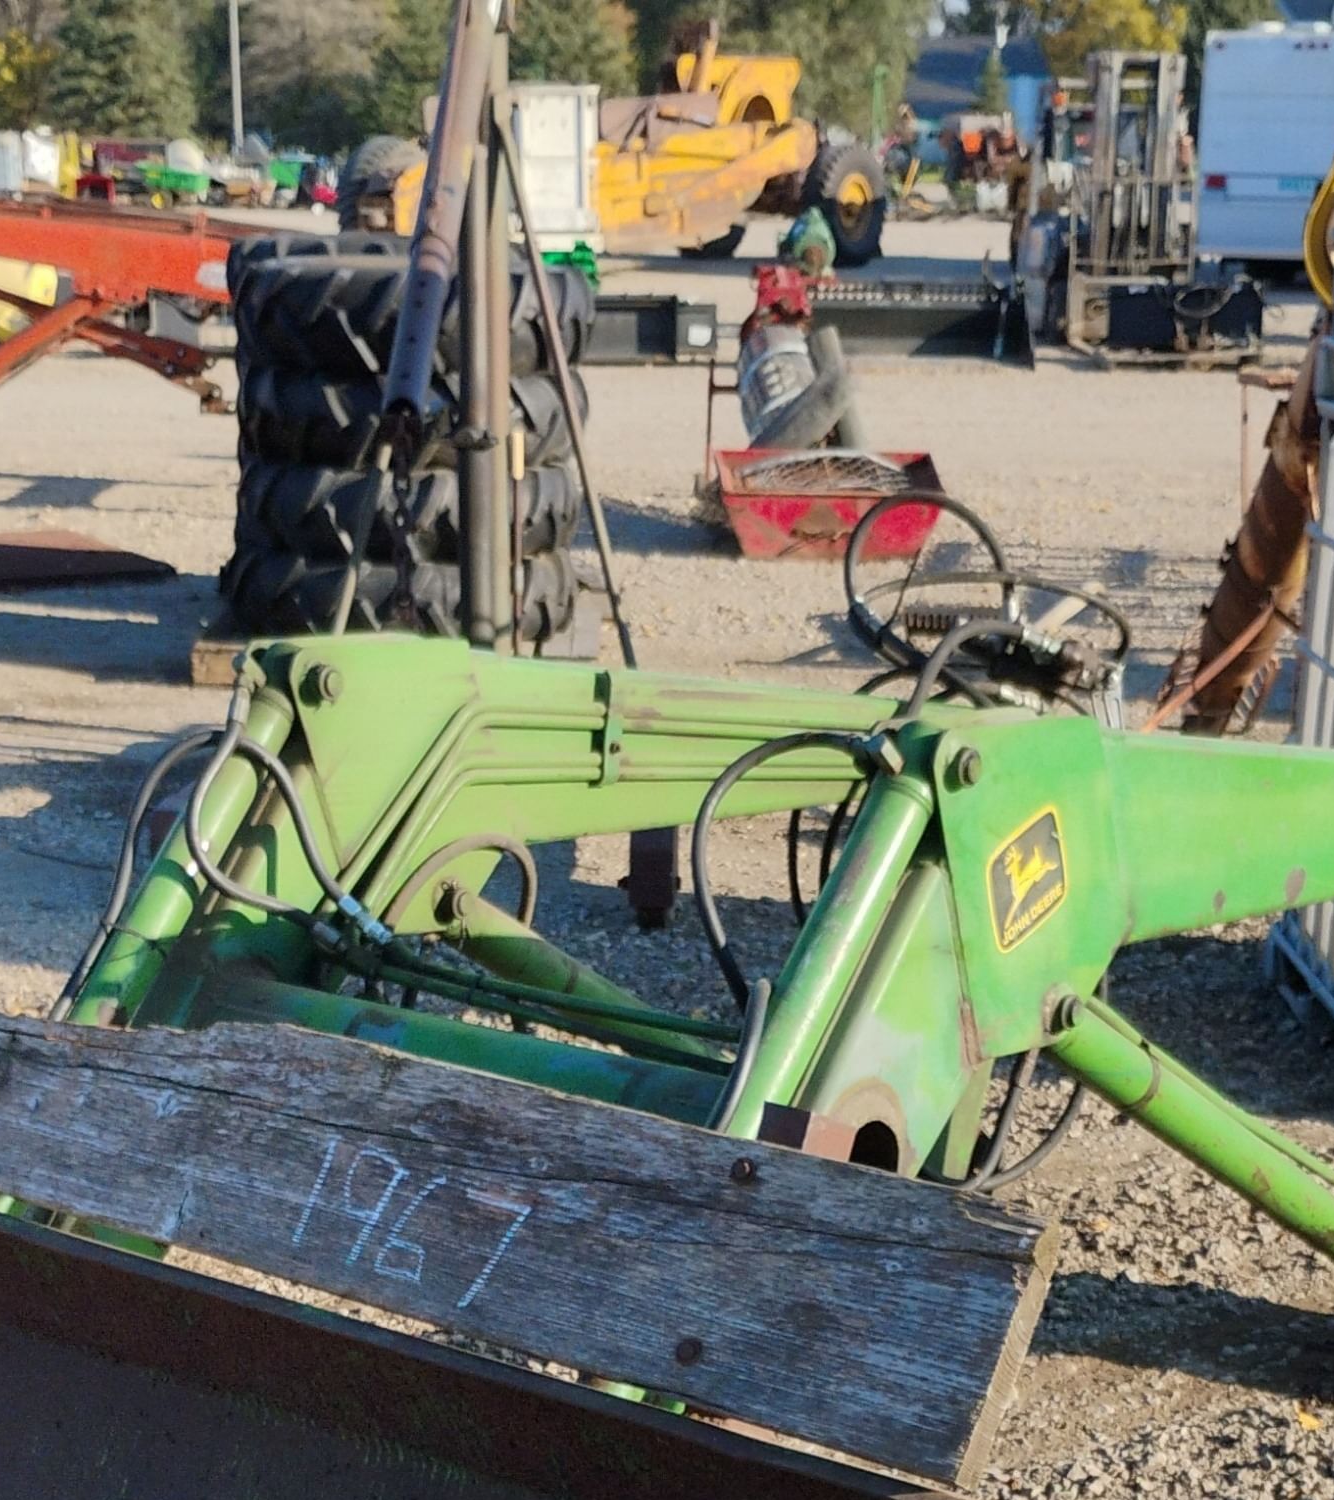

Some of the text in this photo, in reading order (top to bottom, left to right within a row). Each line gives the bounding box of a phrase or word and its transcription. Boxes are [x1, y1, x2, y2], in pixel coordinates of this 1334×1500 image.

[1003, 883, 1065, 946] JOHN DEERE
[290, 1134, 533, 1309] 1967
